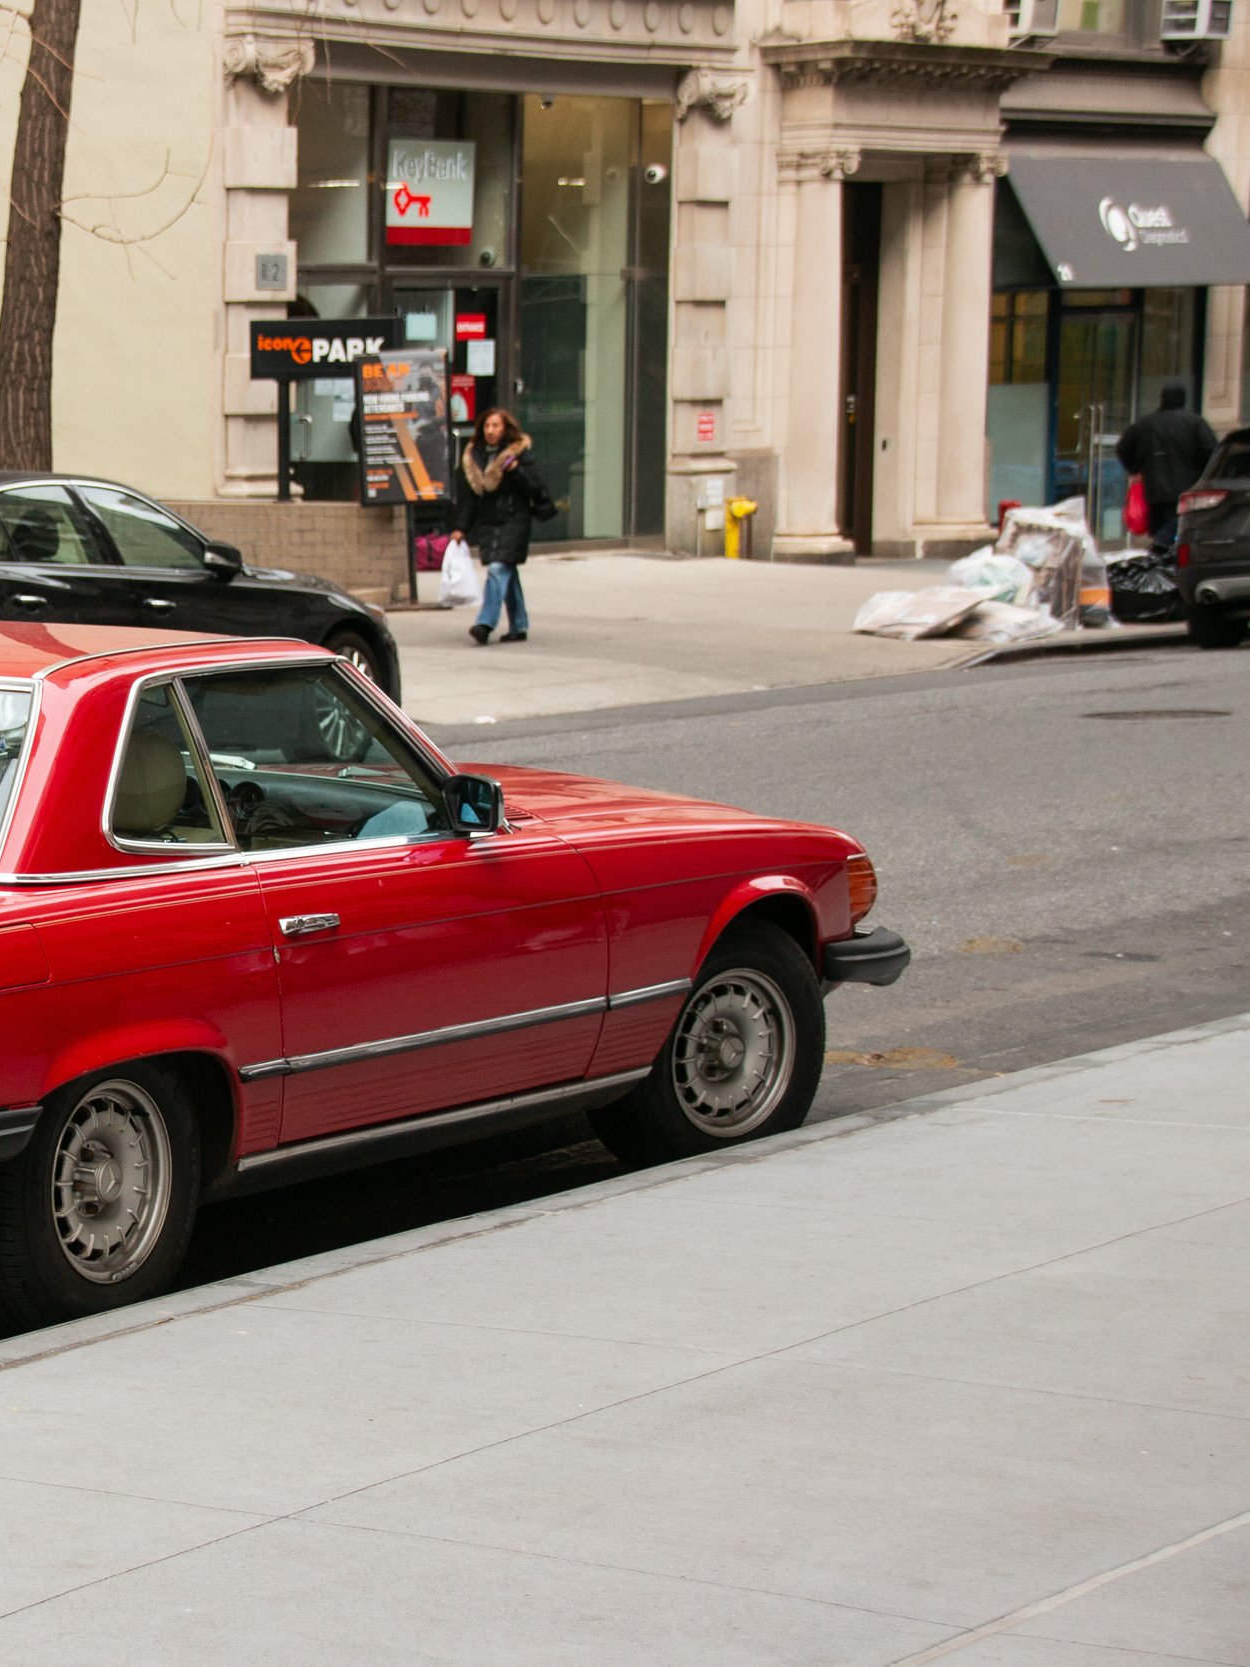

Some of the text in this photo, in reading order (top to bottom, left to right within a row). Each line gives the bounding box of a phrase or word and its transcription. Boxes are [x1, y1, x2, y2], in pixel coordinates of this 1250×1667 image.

[392, 150, 467, 182] KeyBank
[257, 335, 385, 363] icon PARK
